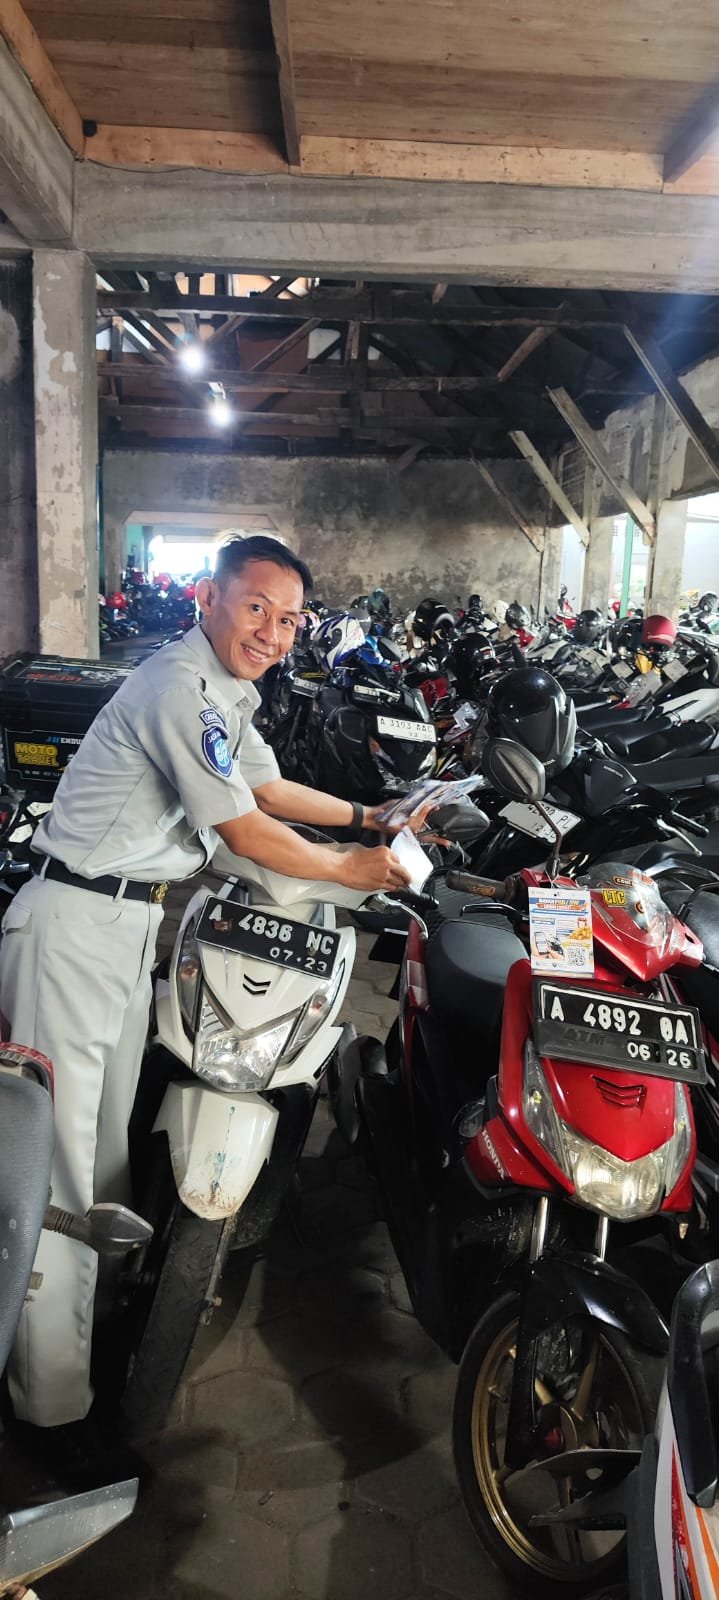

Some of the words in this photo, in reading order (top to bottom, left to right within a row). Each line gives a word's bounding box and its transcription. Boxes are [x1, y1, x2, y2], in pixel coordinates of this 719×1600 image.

[15, 742, 58, 756] MOTO
[17, 754, 59, 767] TRAVEL
[602, 889, 626, 905] LTC
[208, 903, 223, 921] A
[238, 913, 294, 943] 4836
[305, 930, 335, 955] NC
[550, 996, 565, 1022] A
[583, 1002, 642, 1036] 4892
[626, 1041, 651, 1061] 06
[666, 1049, 692, 1069] 26
[481, 1128, 505, 1180] HONDA
